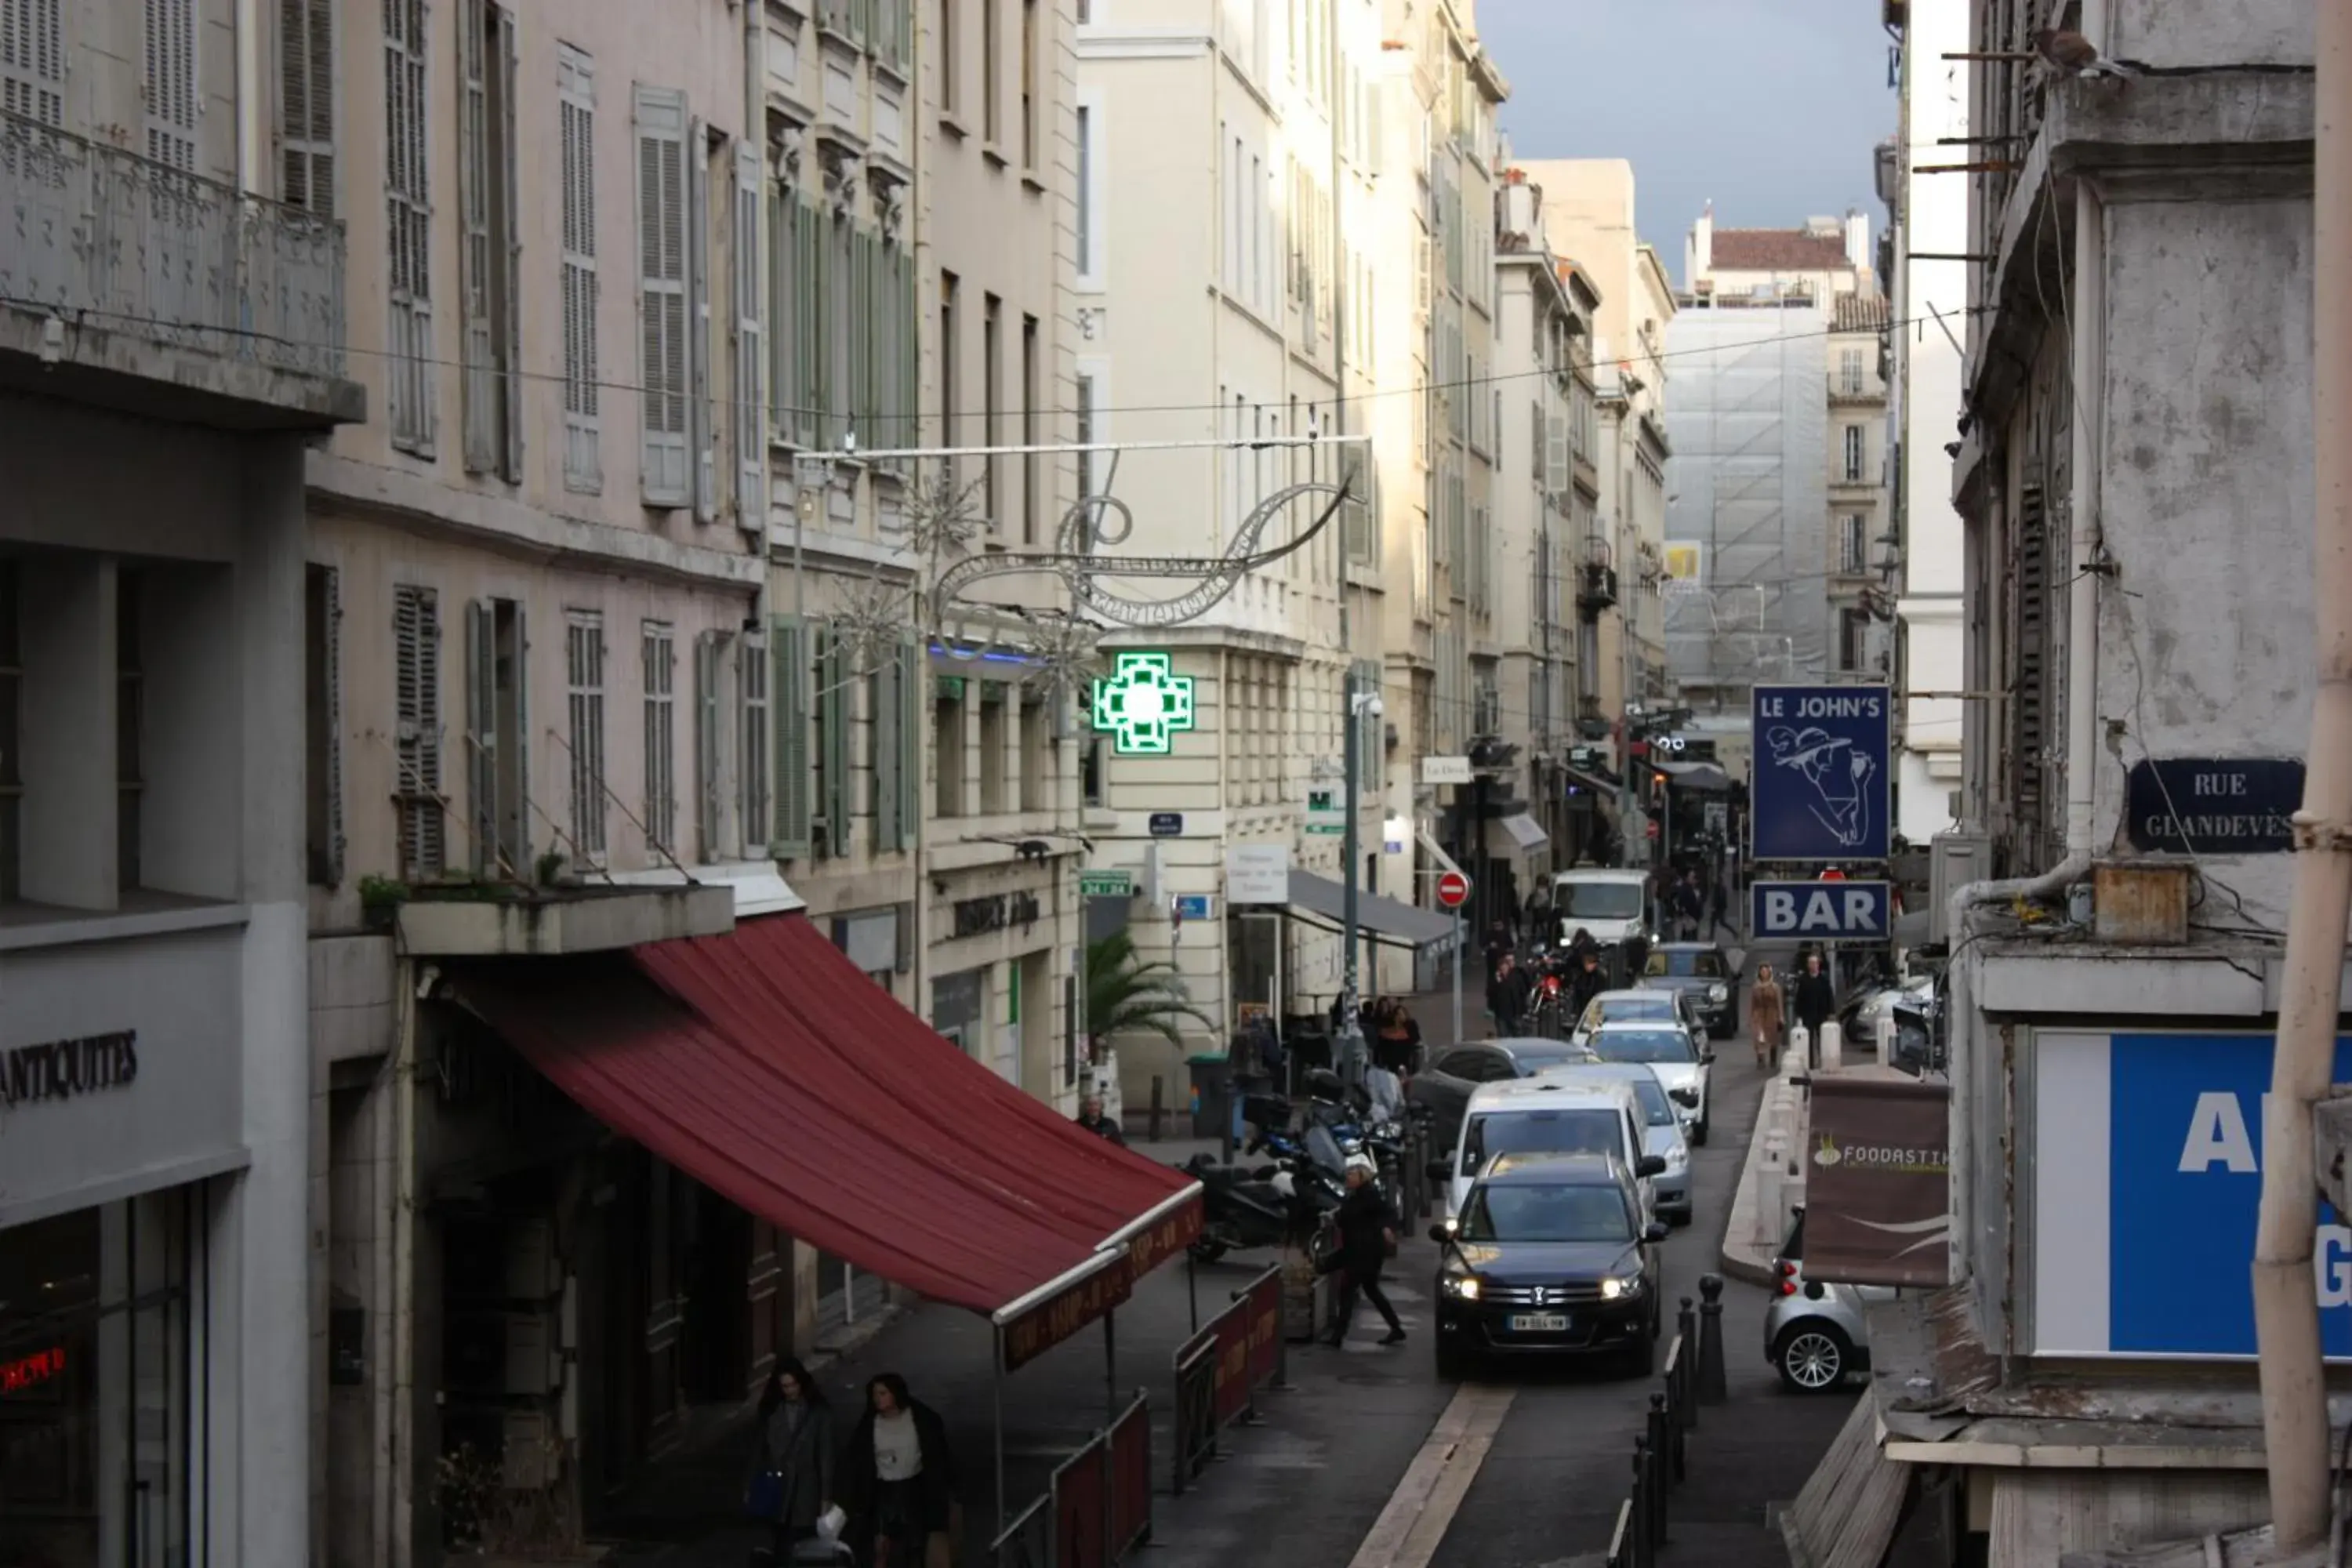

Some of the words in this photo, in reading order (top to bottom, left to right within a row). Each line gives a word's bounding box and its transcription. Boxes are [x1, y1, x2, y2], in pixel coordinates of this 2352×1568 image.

[1761, 697, 1784, 717] LE
[1796, 696, 1880, 718] JOHN'S
[2194, 773, 2247, 796] RUE
[1765, 890, 1878, 931] BAR
